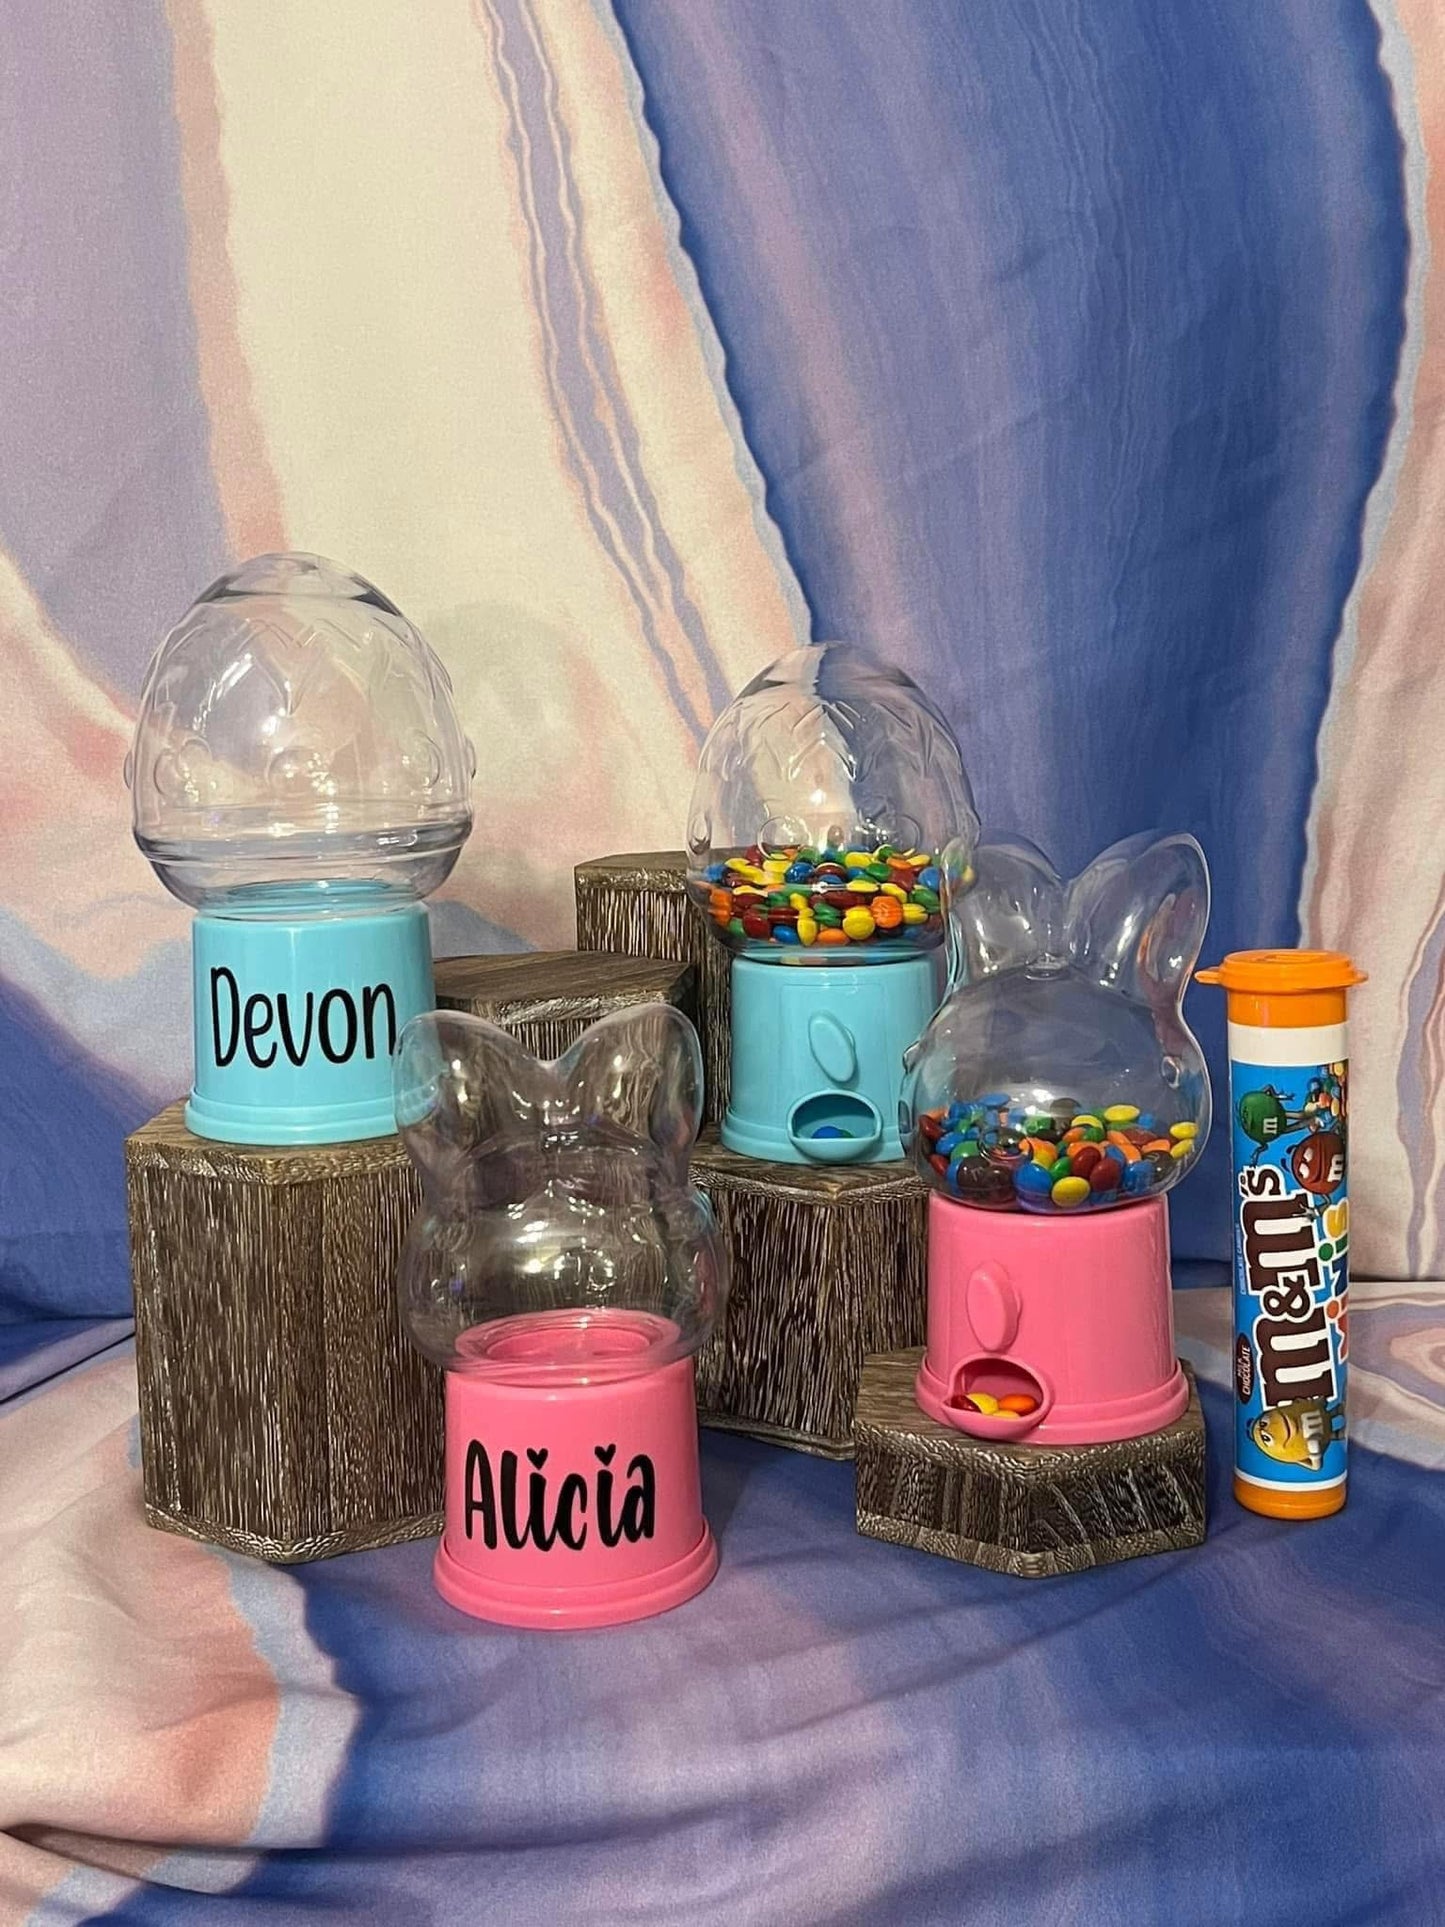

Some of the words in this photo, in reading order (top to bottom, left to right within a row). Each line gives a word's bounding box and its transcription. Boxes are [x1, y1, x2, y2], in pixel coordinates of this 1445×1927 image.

[211, 966, 401, 1069] Devon
[1241, 1344, 1252, 1396] CHOCOLATE
[465, 1439, 656, 1552] Alicia
